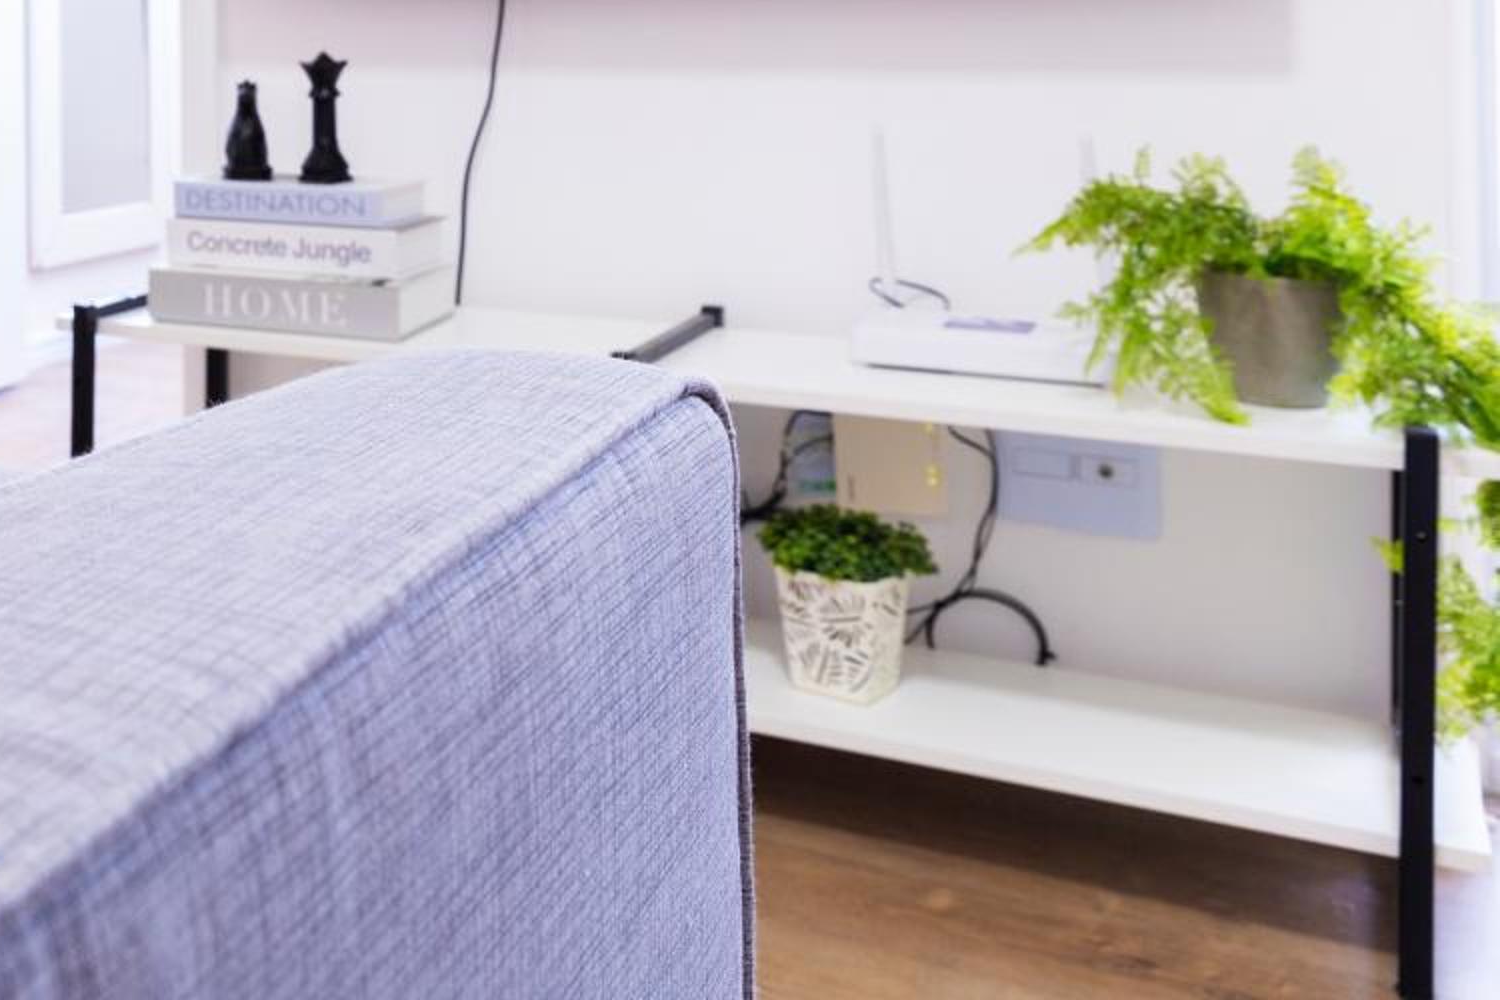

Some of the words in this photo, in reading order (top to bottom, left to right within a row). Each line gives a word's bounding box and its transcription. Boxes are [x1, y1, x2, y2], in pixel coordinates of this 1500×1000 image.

[185, 189, 366, 217] DESTINATION
[187, 230, 287, 258] Concrete
[292, 237, 372, 266] Jungle
[202, 281, 347, 328] HOME
